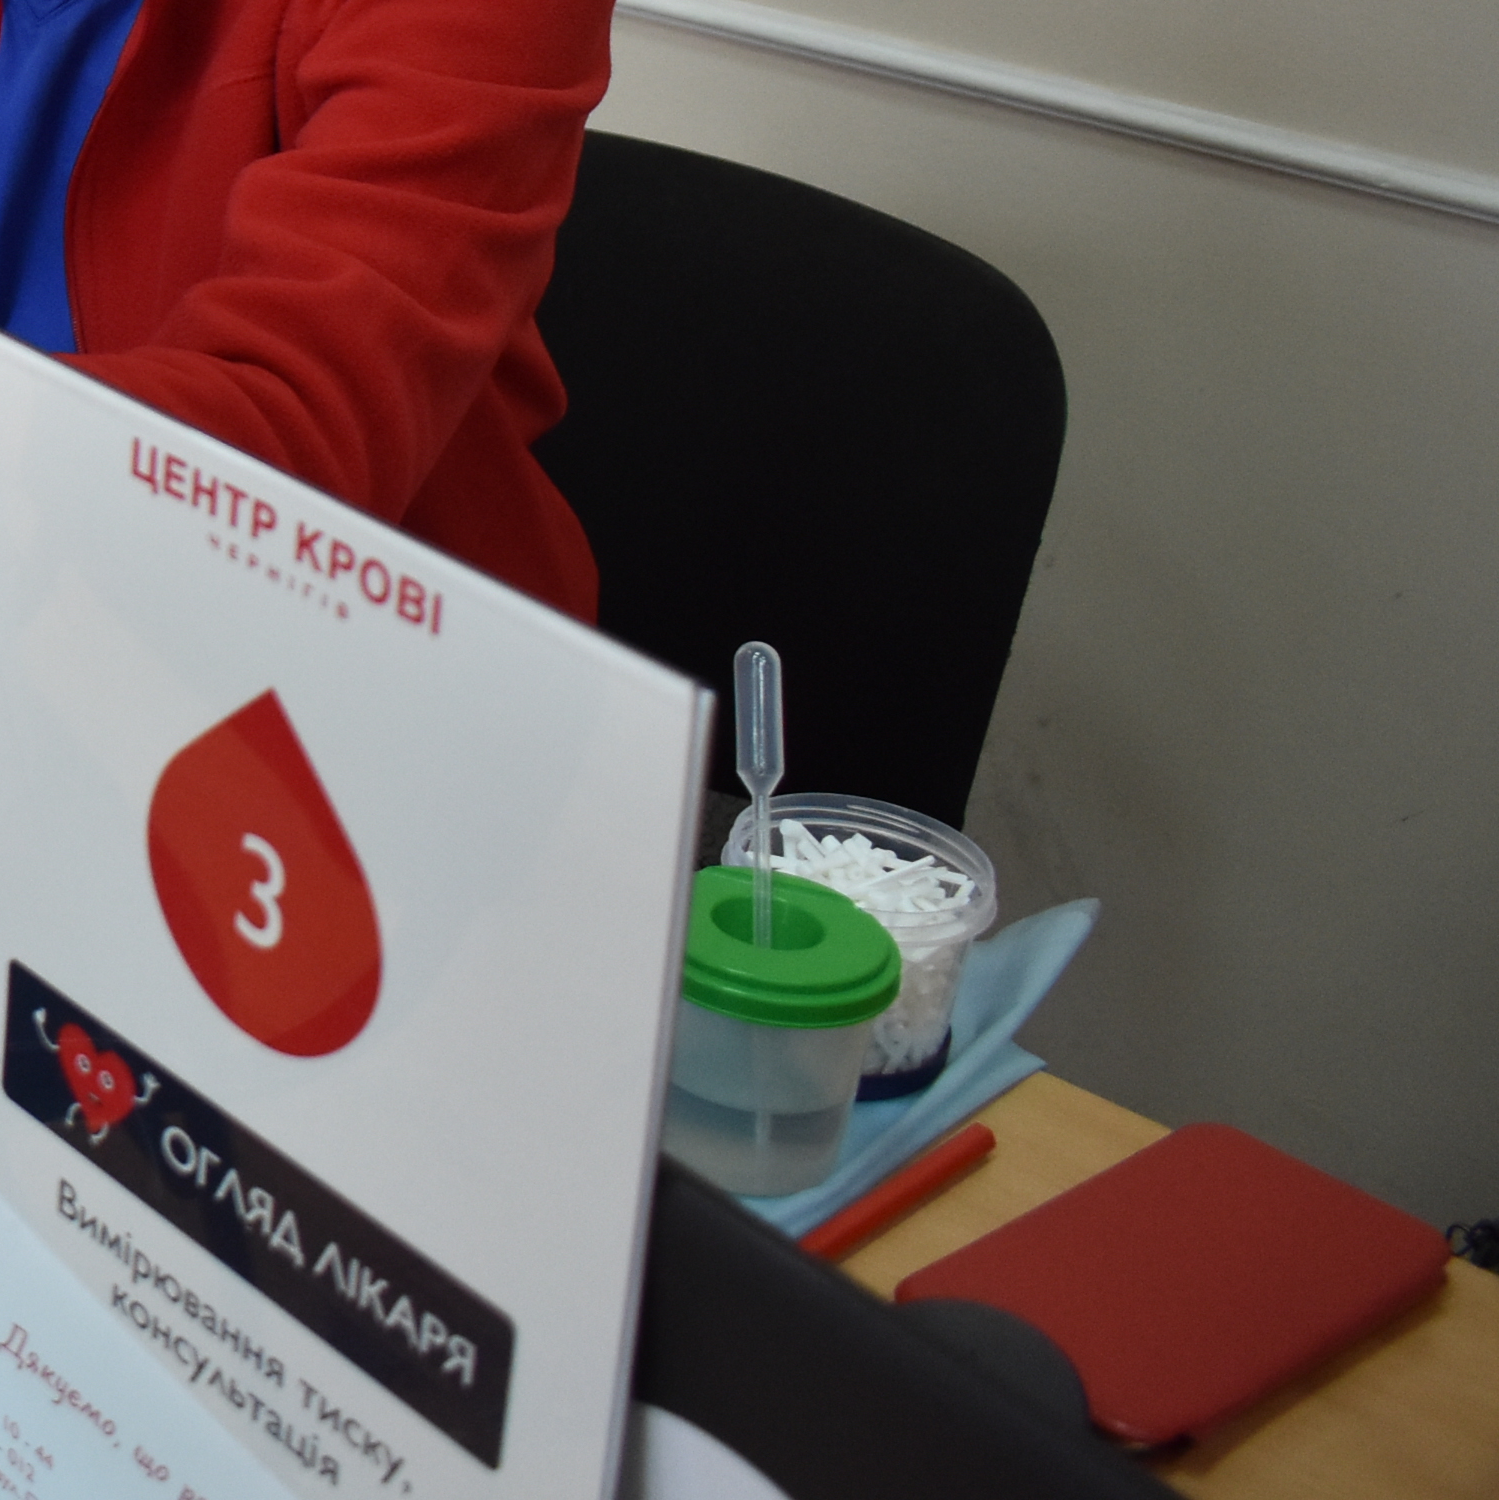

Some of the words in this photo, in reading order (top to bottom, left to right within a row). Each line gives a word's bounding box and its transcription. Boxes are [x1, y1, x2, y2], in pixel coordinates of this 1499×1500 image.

[130, 436, 278, 539] ЦЕНТР
[294, 520, 443, 636] КРОВІ
[233, 832, 287, 950] 3
[56, 1177, 285, 1388] Вимірювання
[298, 1377, 414, 1495] тиску,
[160, 1125, 305, 1268] ОГЛЯД
[313, 1241, 478, 1387] ЛІКАРЯ
[110, 1283, 341, 1487] консультація
